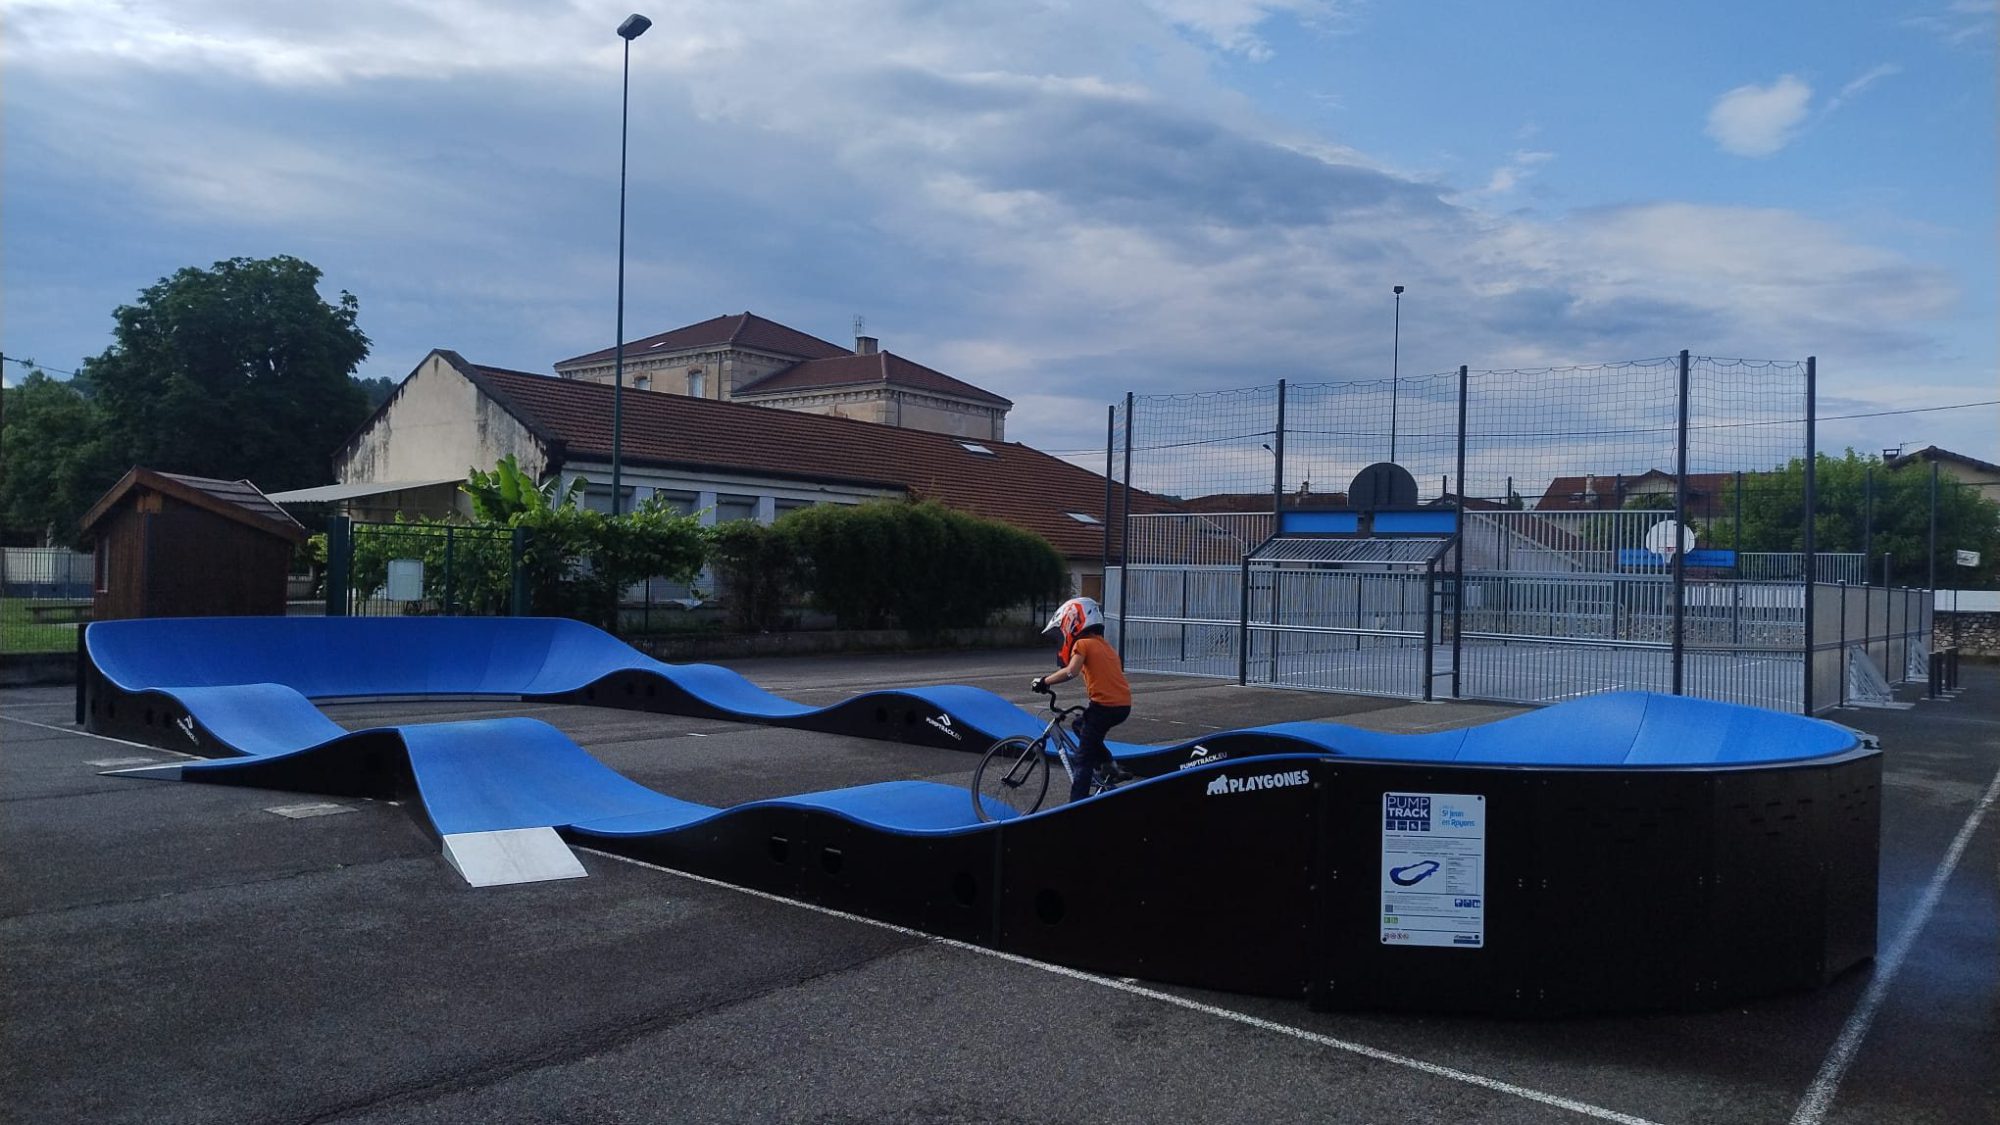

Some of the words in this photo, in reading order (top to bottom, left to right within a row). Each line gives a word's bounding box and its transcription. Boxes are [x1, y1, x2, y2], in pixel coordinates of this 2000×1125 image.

[1229, 770, 1310, 793] PLAYGONES
[1388, 797, 1430, 808] PUMP
[1388, 808, 1428, 818] TRACK
